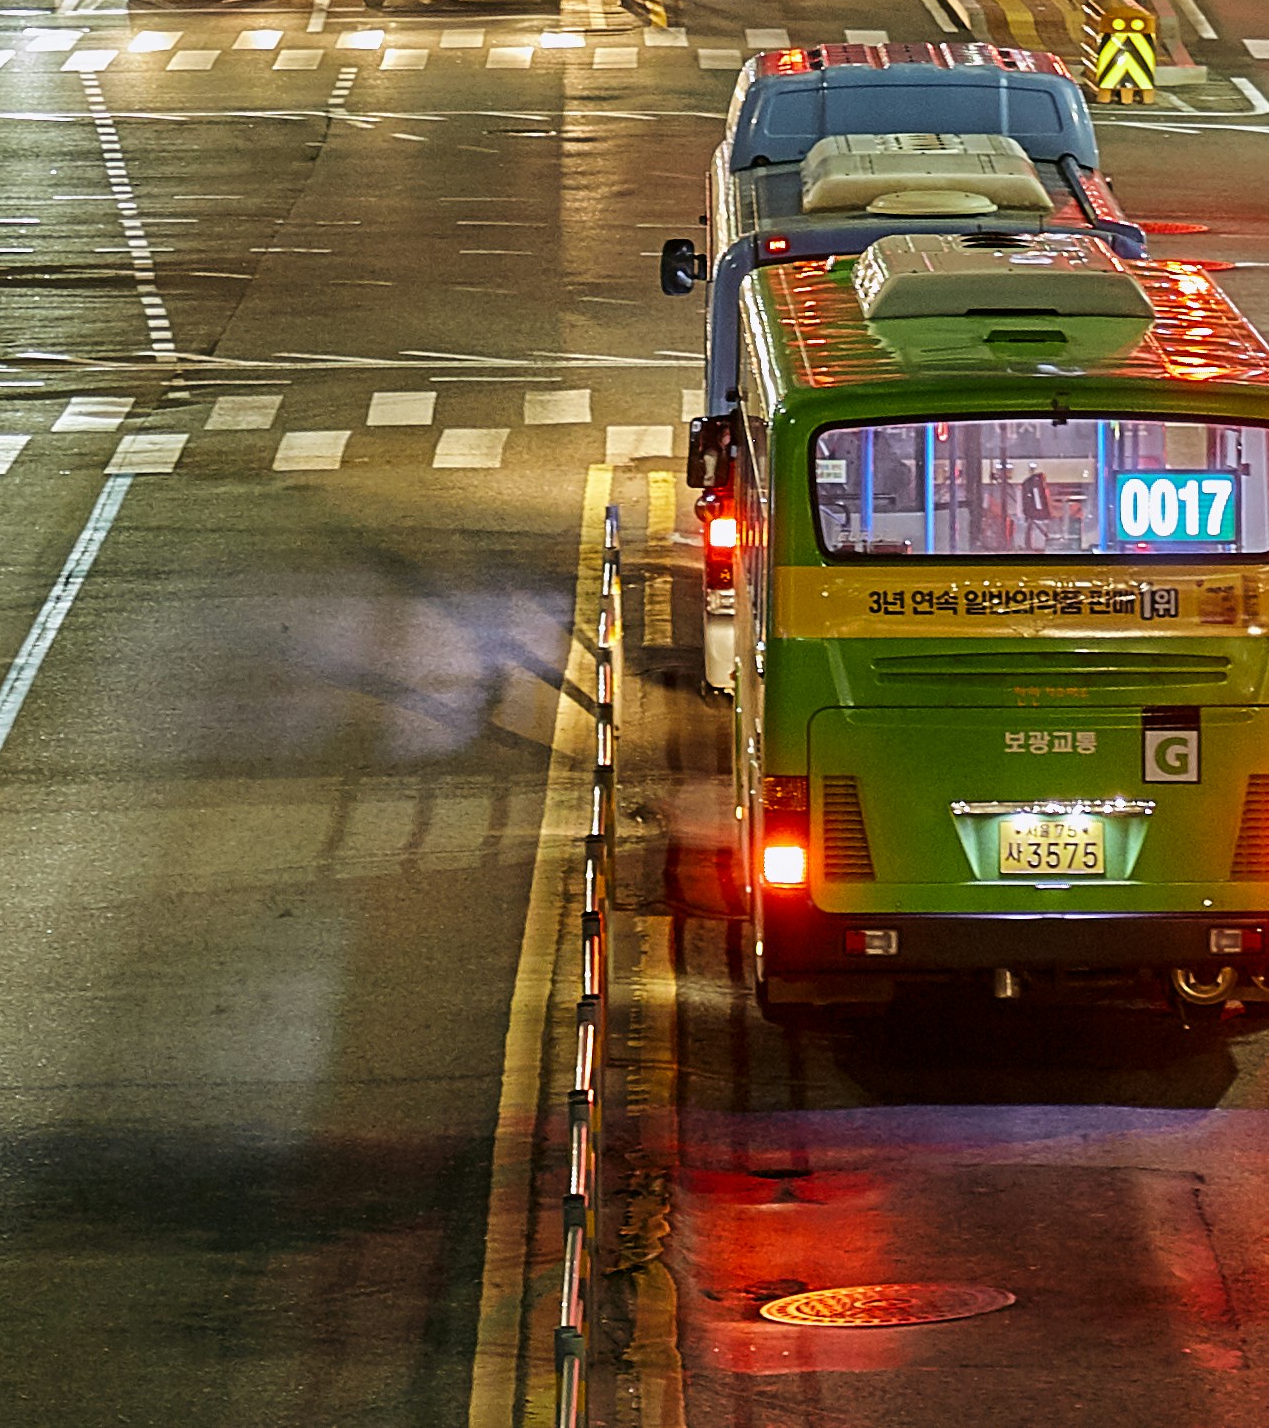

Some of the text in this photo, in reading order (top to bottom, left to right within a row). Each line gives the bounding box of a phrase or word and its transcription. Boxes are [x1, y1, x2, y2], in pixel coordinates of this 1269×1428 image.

[1119, 478, 1233, 538] 0017
[867, 589, 906, 616] 3년
[910, 589, 960, 616] 연속
[963, 589, 1085, 616] 일반의약품
[1138, 583, 1180, 621] 1위
[1004, 730, 1098, 754] 보광교통
[1154, 736, 1190, 776] G
[1025, 824, 1050, 839] 서울
